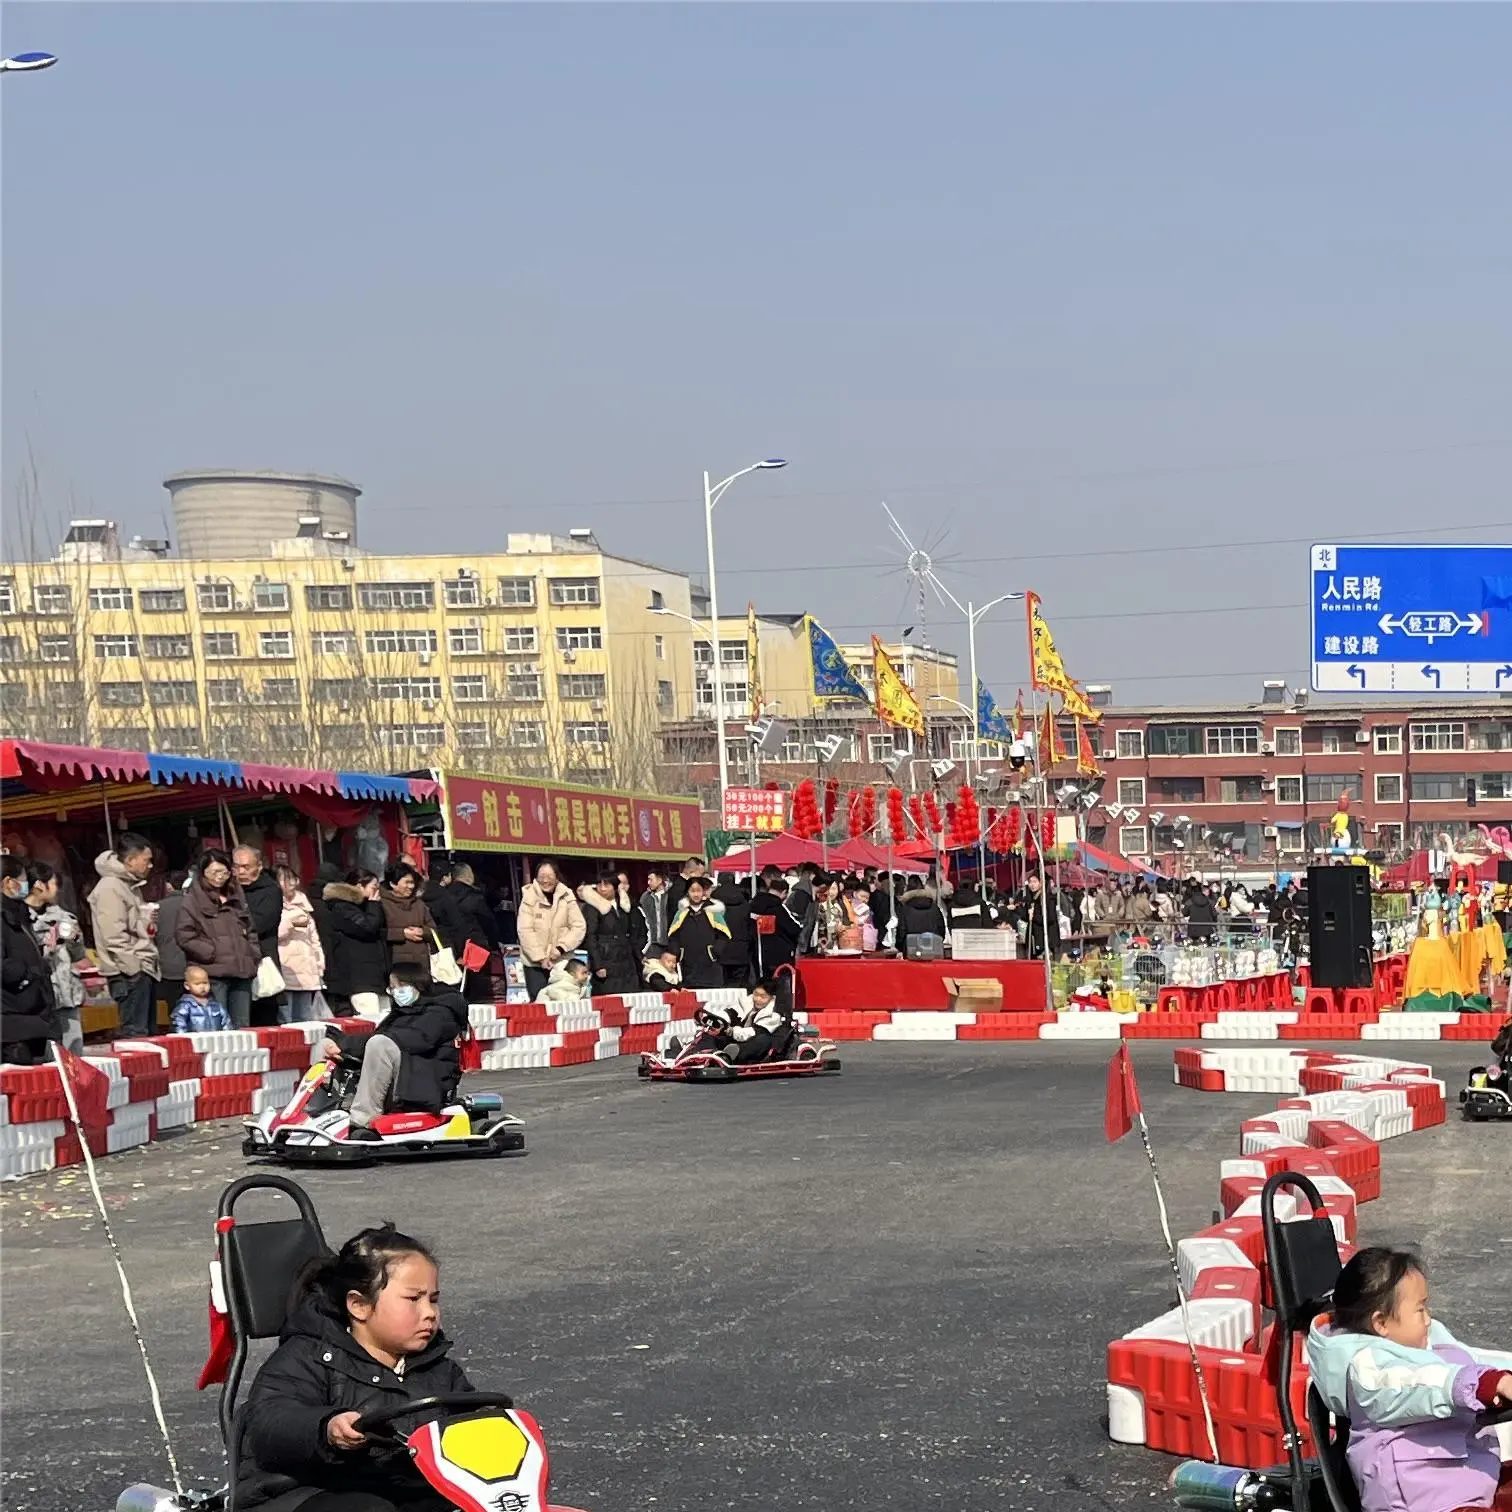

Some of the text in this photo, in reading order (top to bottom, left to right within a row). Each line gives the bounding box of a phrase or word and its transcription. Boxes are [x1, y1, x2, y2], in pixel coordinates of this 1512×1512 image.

[1319, 550, 1332, 562] 北
[1321, 575, 1382, 600] 人民路
[1321, 602, 1363, 612] Renmin
[1409, 615, 1452, 632] 轻工路
[1323, 635, 1380, 655] 建设路
[554, 796, 631, 845] 我是神枪手
